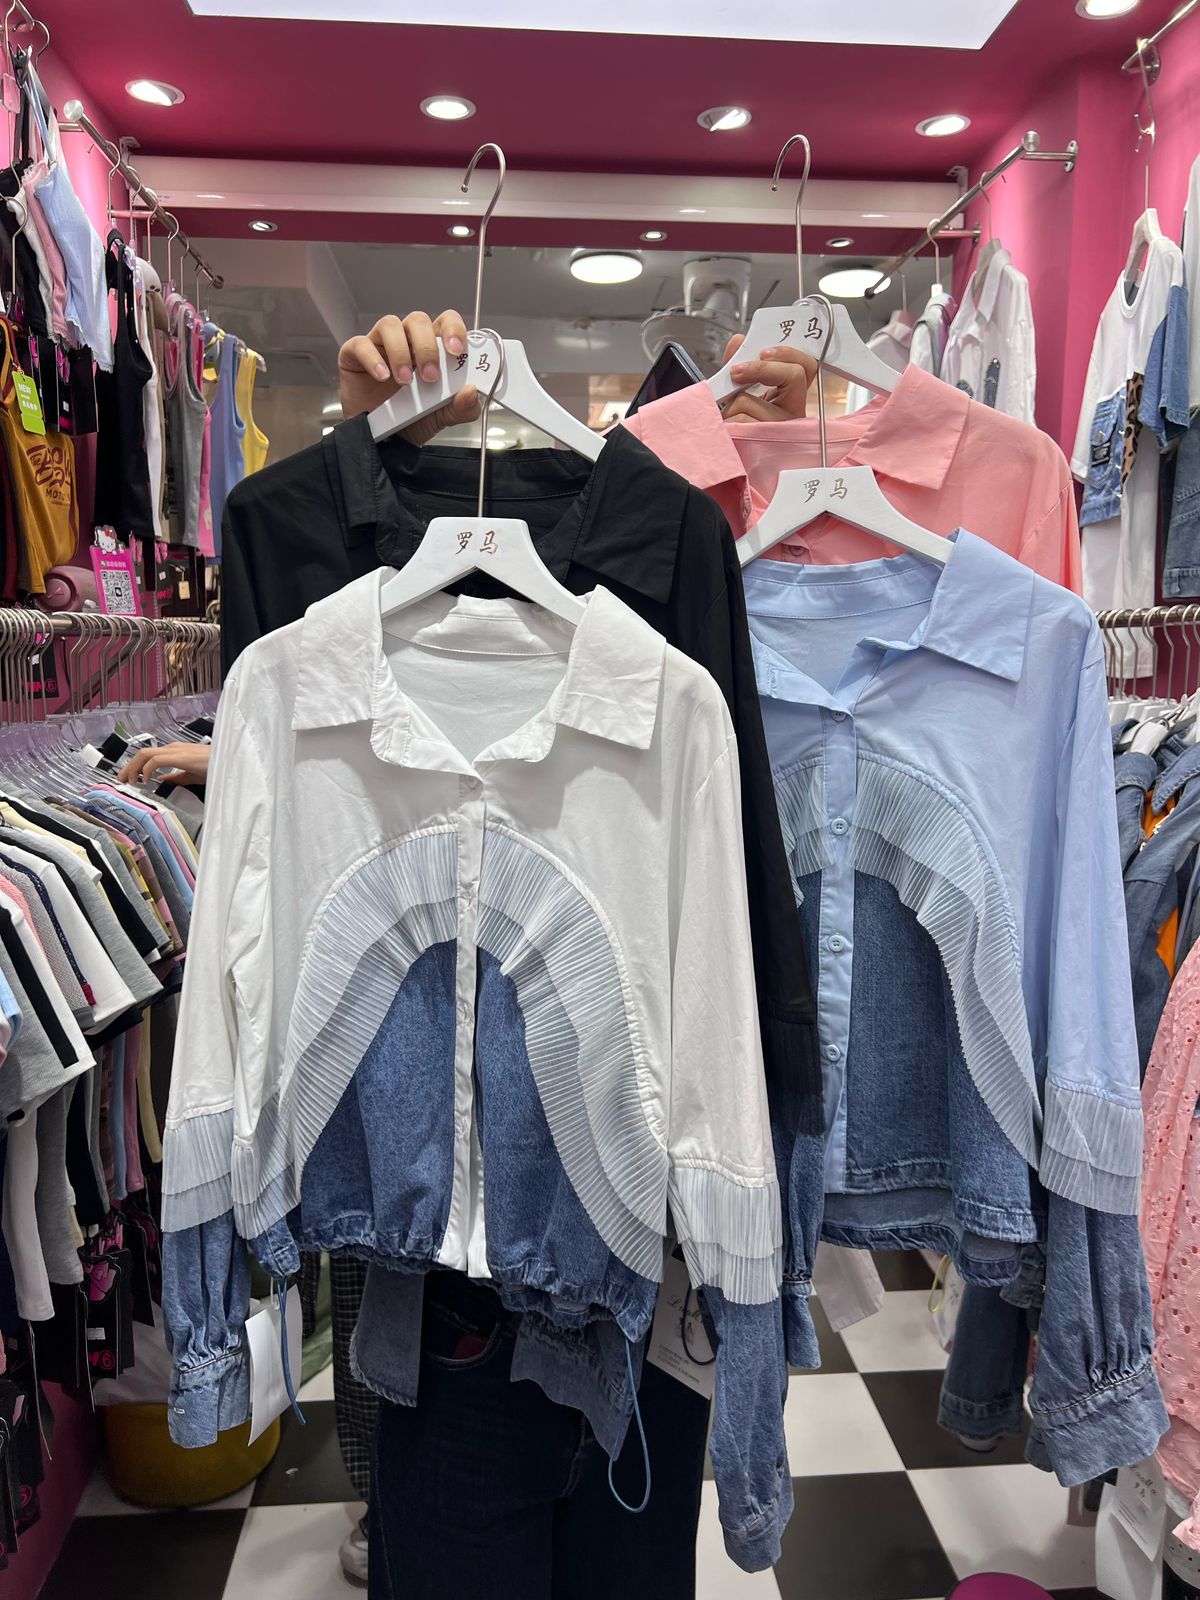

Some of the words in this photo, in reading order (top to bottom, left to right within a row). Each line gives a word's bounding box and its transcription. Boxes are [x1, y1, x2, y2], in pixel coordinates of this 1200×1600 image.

[778, 317, 823, 343] 罗马
[454, 352, 491, 372] 罗马
[803, 477, 848, 503] 罗马
[455, 530, 499, 555] 罗马
